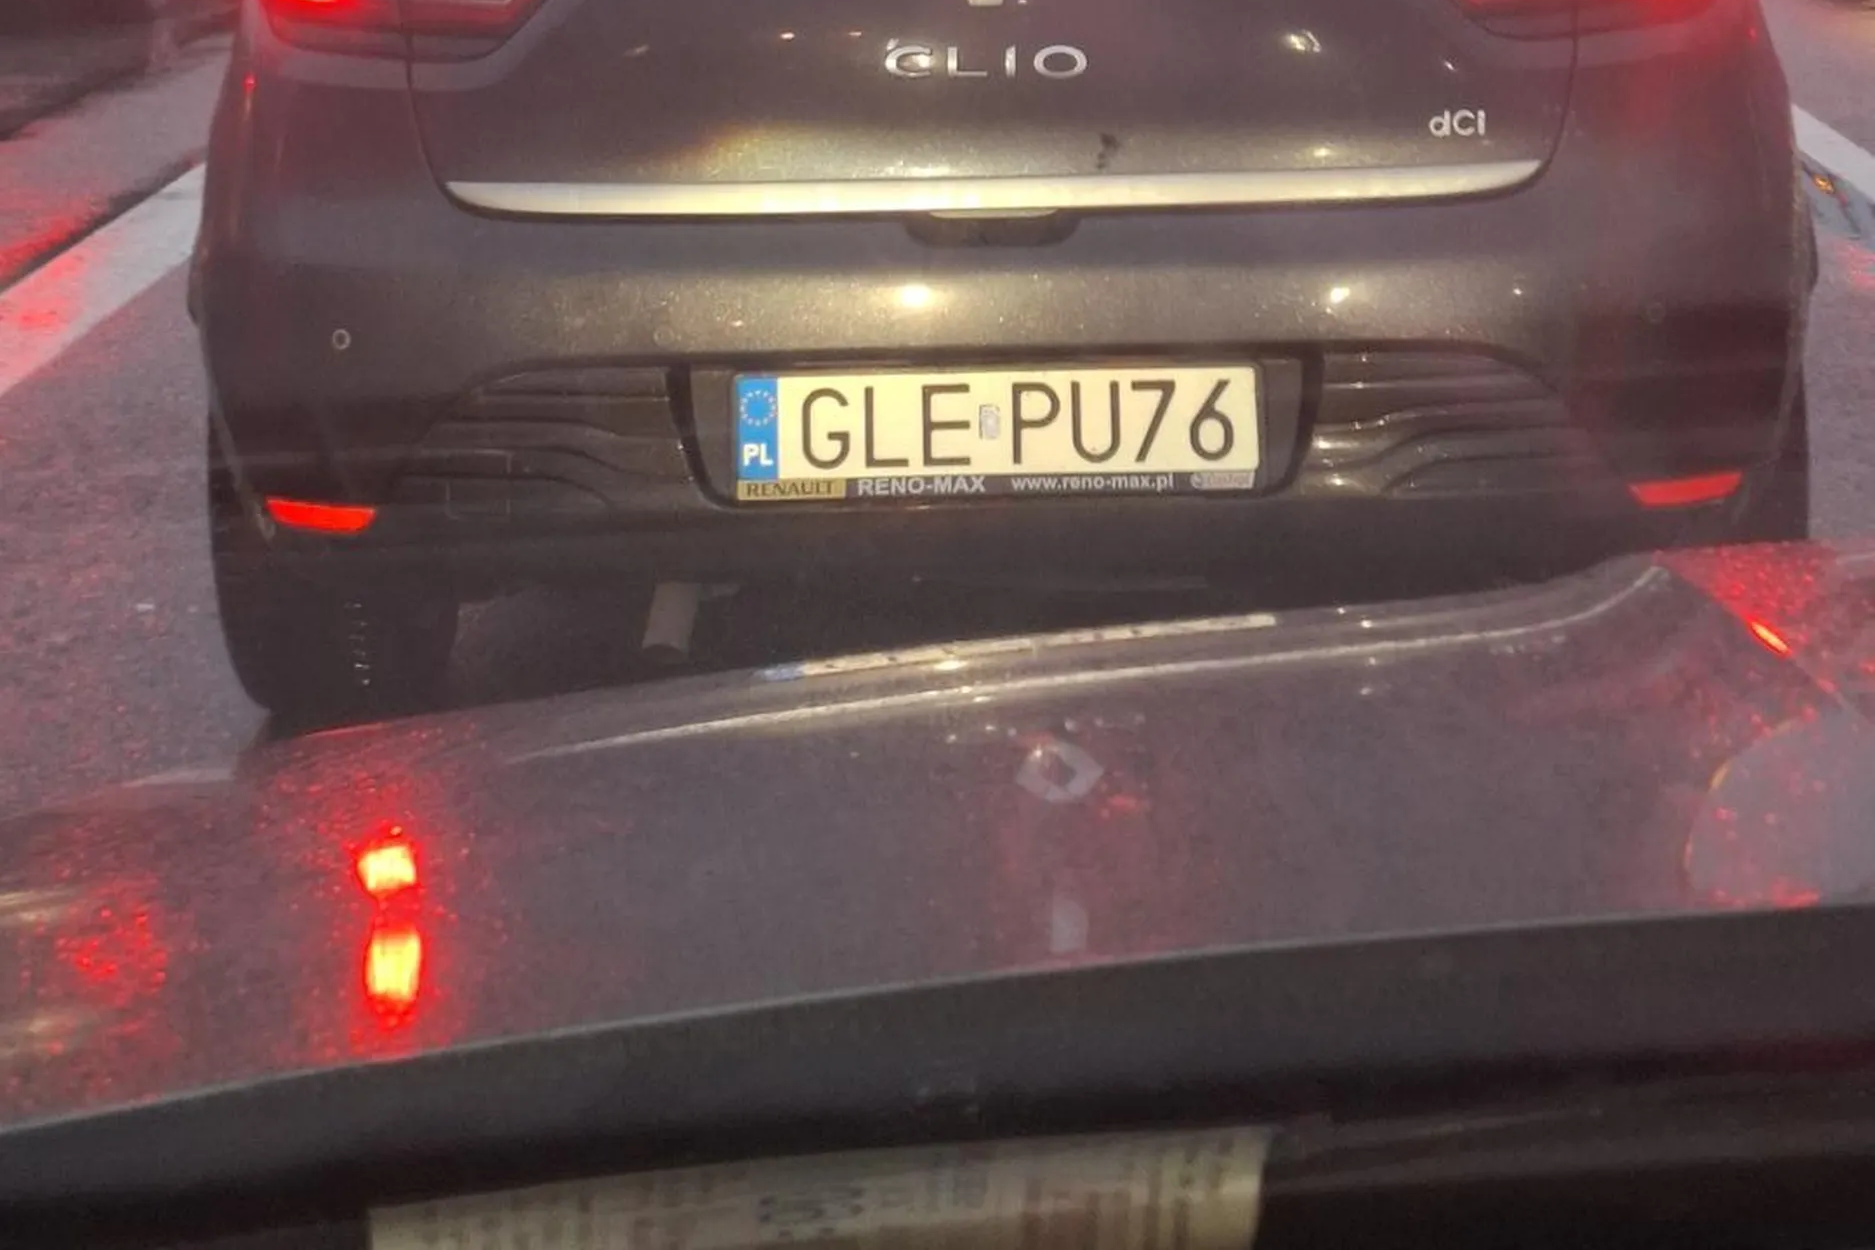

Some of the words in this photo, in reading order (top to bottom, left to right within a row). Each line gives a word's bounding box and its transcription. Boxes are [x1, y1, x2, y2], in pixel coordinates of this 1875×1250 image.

[885, 44, 1088, 79] CLIO
[801, 383, 971, 470] GLE
[1012, 378, 1235, 465] PU76
[742, 443, 774, 467] PL
[746, 479, 834, 498] RENAULT
[857, 474, 987, 496] RENO-MAX
[1010, 472, 1175, 492] www.reno-max.pl
